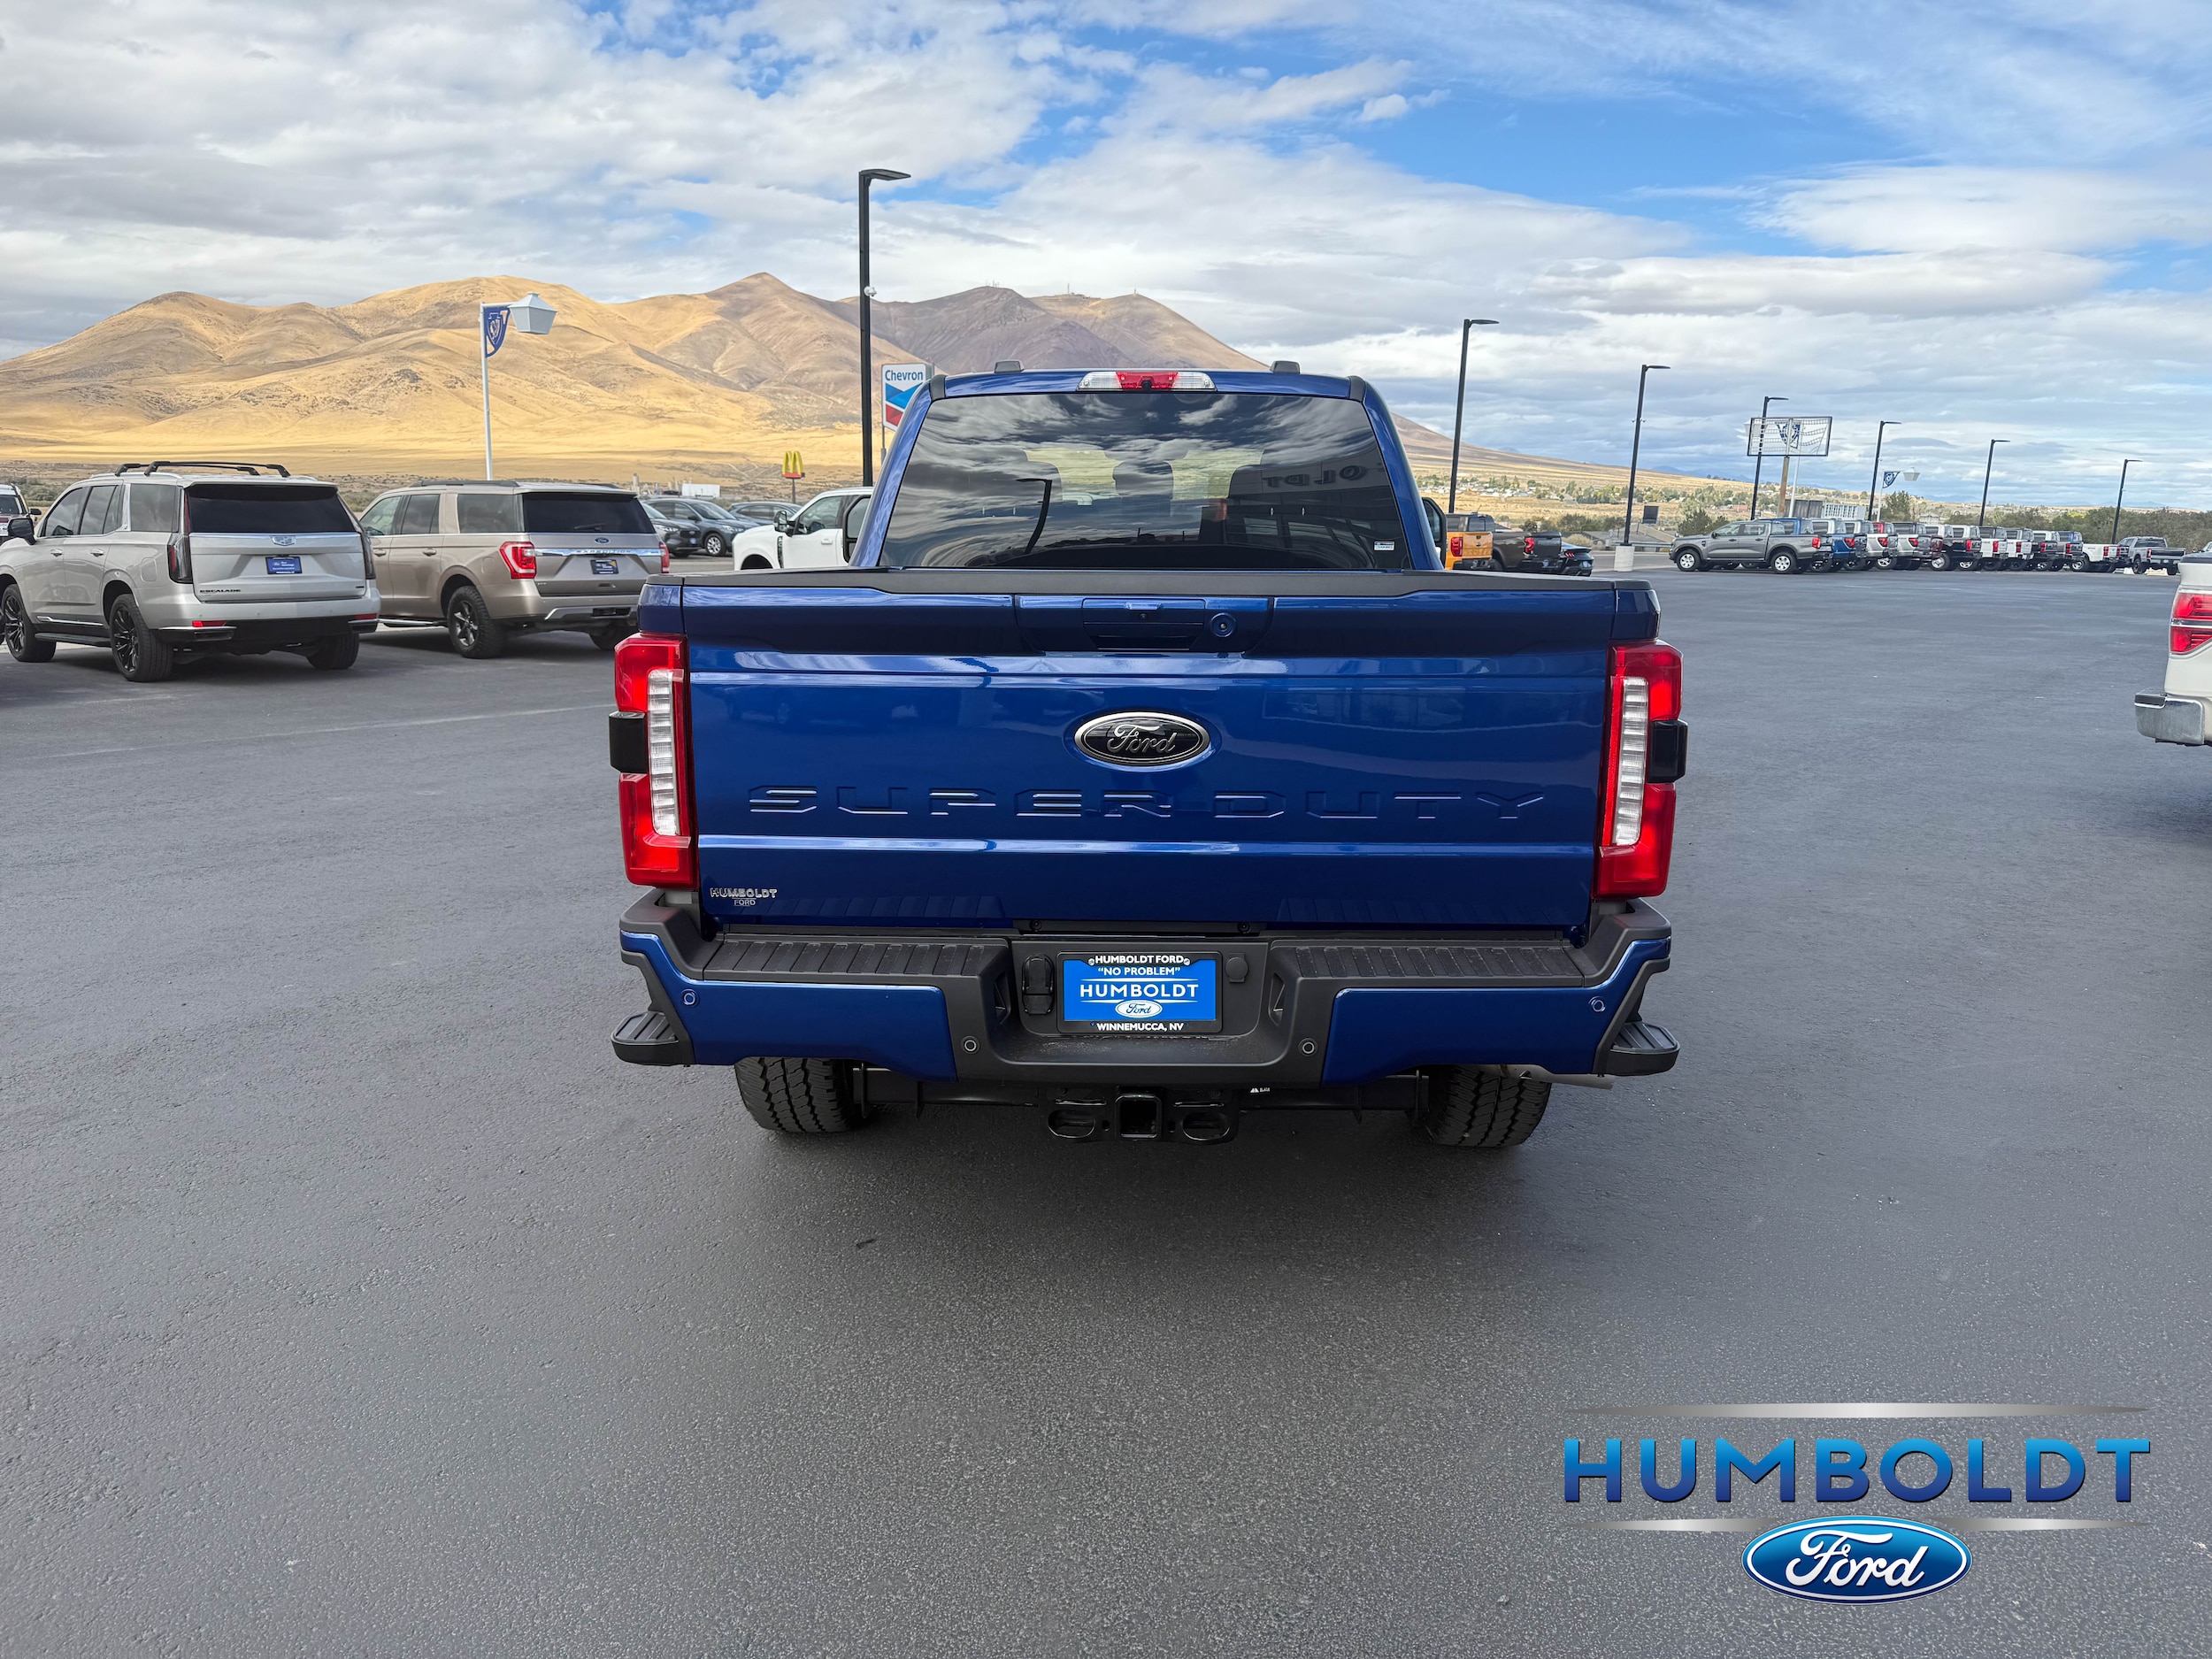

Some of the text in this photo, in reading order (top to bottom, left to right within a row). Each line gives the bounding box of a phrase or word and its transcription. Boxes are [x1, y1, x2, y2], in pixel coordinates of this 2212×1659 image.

[885, 370, 923, 380] Chevron
[1107, 724, 1178, 753] Ford
[749, 785, 1545, 818] SUPER DUTY
[710, 887, 778, 898] HUMBOLDT
[1094, 955, 1184, 964] HUMBOLDT FORD
[1079, 984, 1199, 997] HUMBOLDT
[1125, 1003, 1152, 1014] Ford
[1096, 1023, 1167, 1032] WINNEMUCCA,
